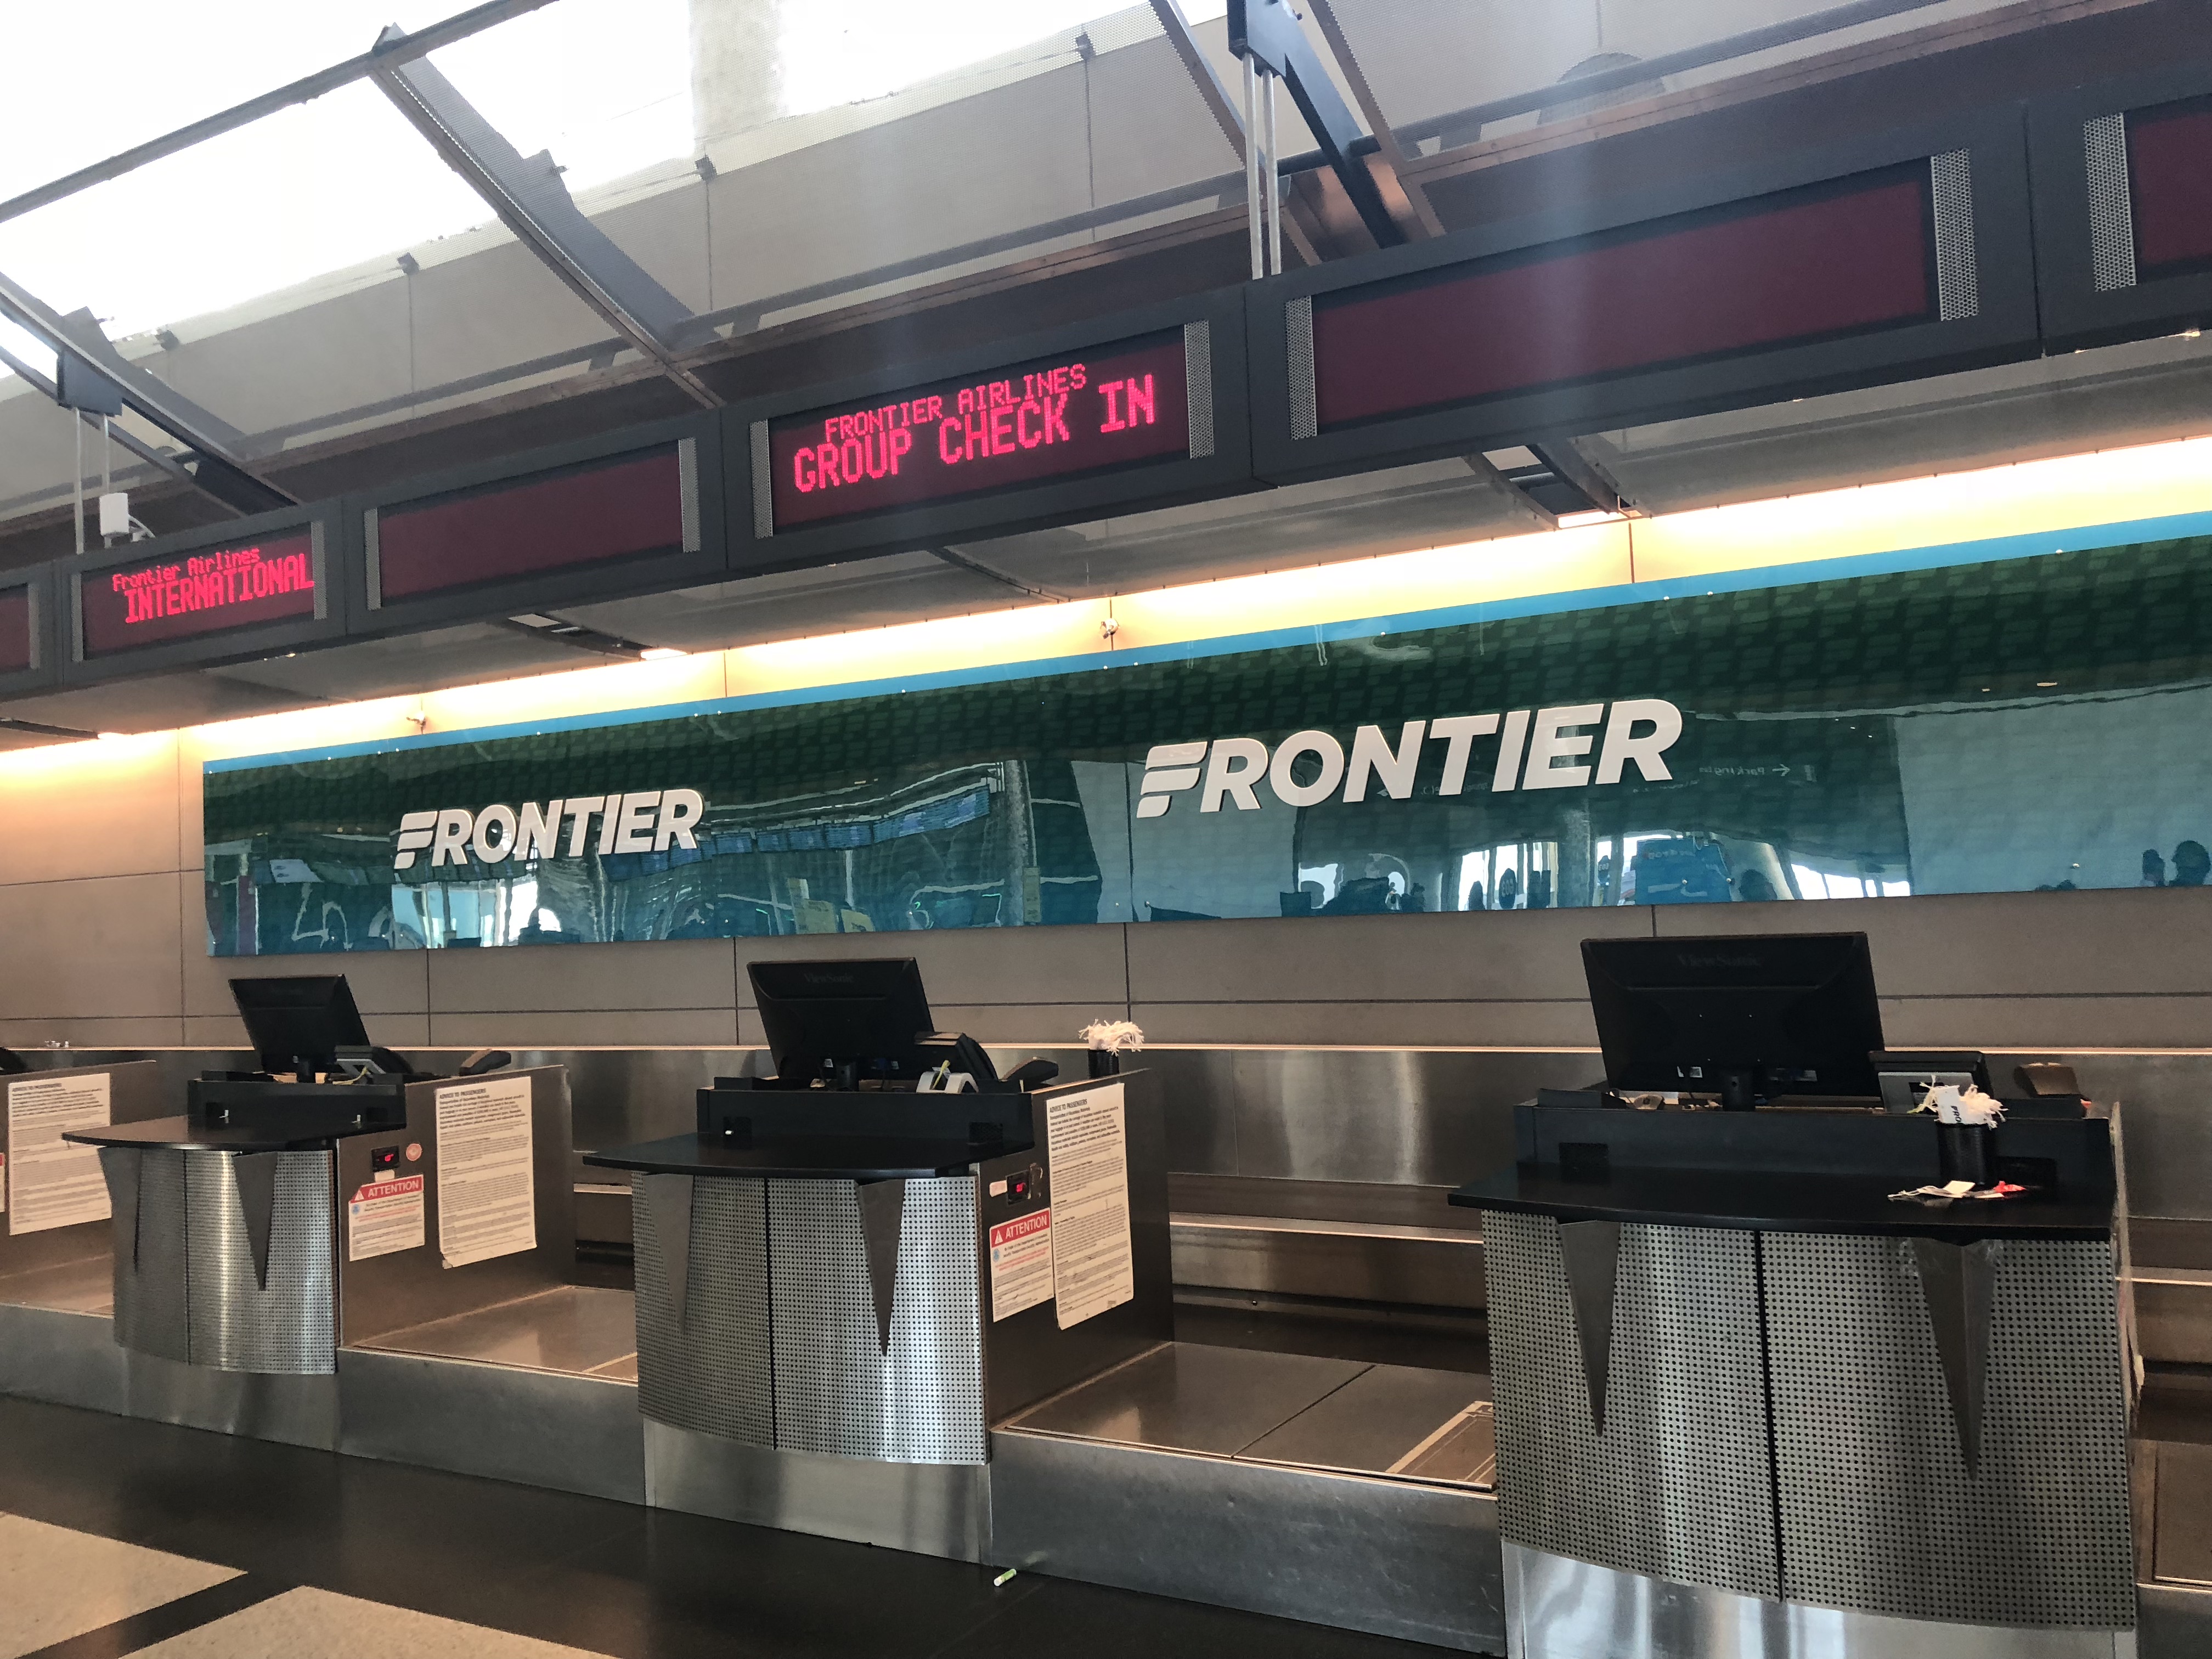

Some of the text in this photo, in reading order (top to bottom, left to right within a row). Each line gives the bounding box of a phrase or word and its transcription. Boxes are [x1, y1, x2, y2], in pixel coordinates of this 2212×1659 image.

[794, 374, 1155, 493] GROUP CHECK IN
[825, 363, 1087, 442] FRONTIER AIRLINES
[112, 548, 260, 592] Frontier Airlines
[124, 553, 315, 624] INTERNATIONAL
[1136, 698, 1683, 819] FRONTIER
[393, 788, 704, 870] FRONTIER
[368, 1180, 420, 1198] ATTENTION
[1005, 1214, 1048, 1240] ATTENTION
